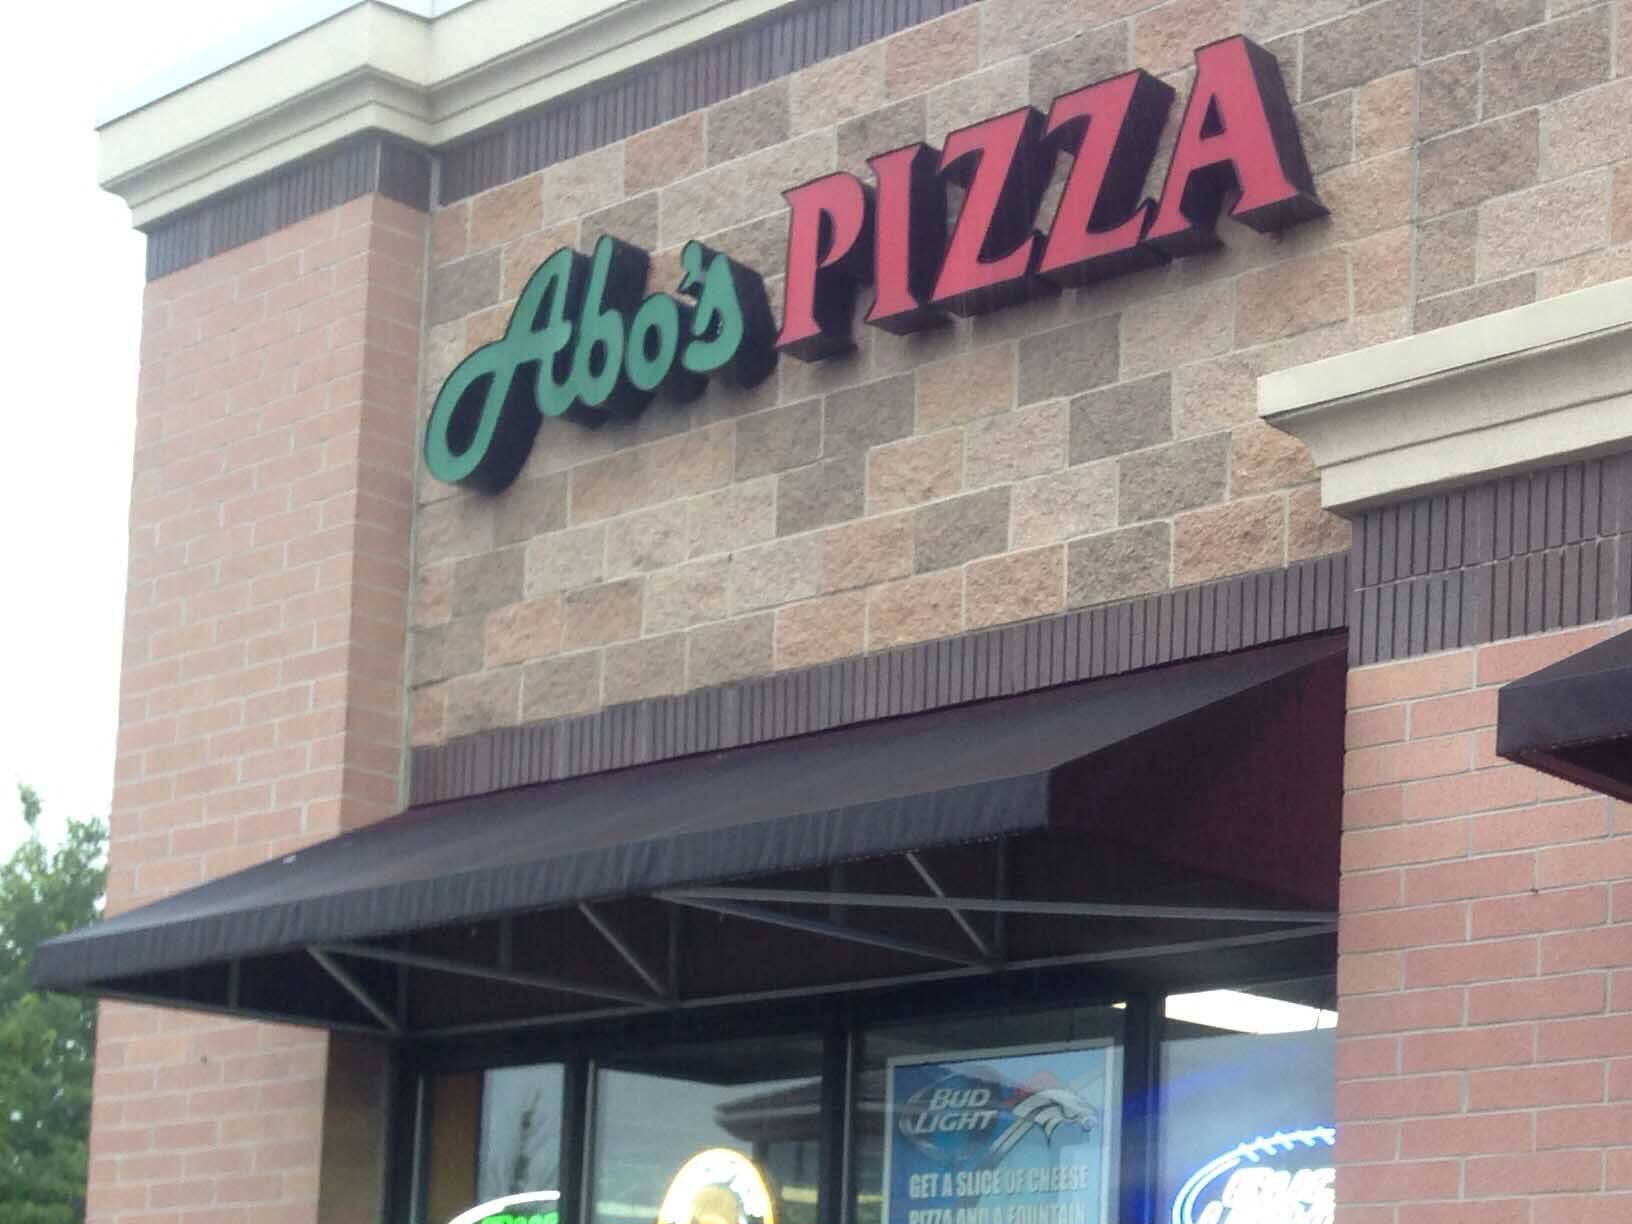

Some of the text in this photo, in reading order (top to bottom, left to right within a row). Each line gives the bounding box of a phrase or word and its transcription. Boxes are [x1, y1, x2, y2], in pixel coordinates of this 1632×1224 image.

[424, 34, 1312, 488] Abo's PIZZA
[930, 1089, 990, 1107] BUD
[911, 1109, 999, 1135] LIGHT
[909, 1165, 1088, 1199] GET A SLICE OF CHEESE
